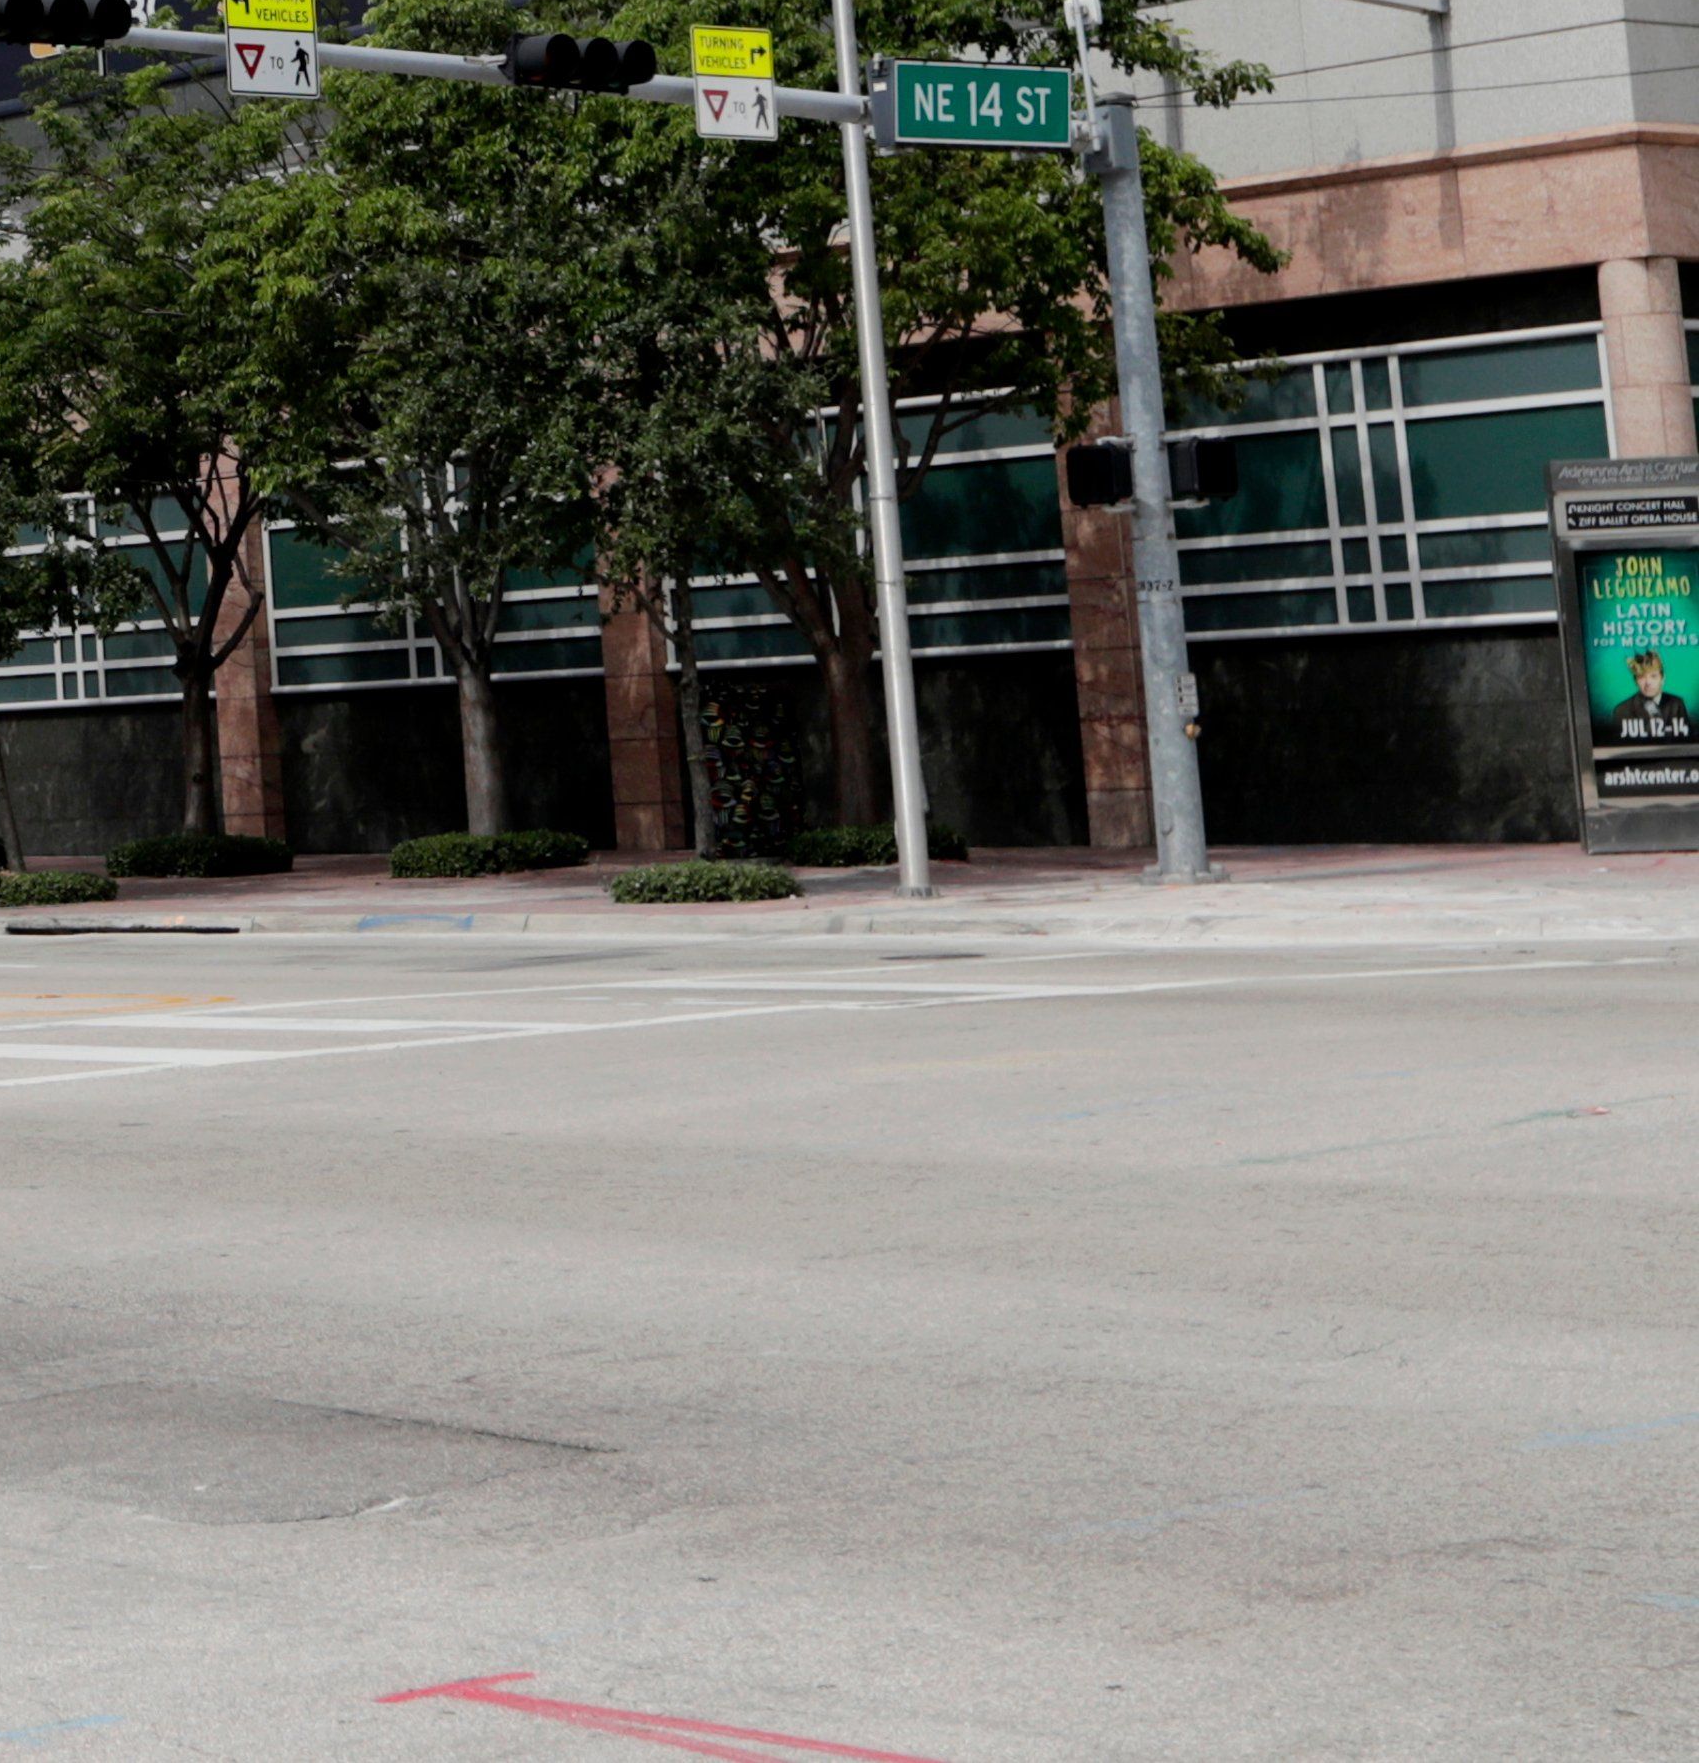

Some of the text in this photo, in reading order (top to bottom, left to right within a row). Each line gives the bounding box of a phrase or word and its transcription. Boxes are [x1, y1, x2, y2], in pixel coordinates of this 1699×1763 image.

[255, 8, 309, 24] VEHICLES
[699, 36, 744, 51] TURNING
[270, 56, 284, 70] TO
[699, 55, 747, 70] VEHICLES
[733, 101, 746, 114] TO
[914, 81, 1051, 127] NE 14 ST
[1616, 500, 1661, 512] CONCERT
[1663, 499, 1685, 511] HALL
[1599, 515, 1629, 526] BALLET
[1631, 513, 1662, 524] OPERA
[1663, 512, 1698, 523] HOUSE
[1615, 556, 1663, 578] JOHN
[1593, 575, 1691, 600] LEGUIZAMO
[1616, 602, 1671, 618] LATIN
[1603, 619, 1686, 636] HISTORY
[1621, 634, 1699, 647] MORONS
[1621, 717, 1689, 738] JUL 12-14
